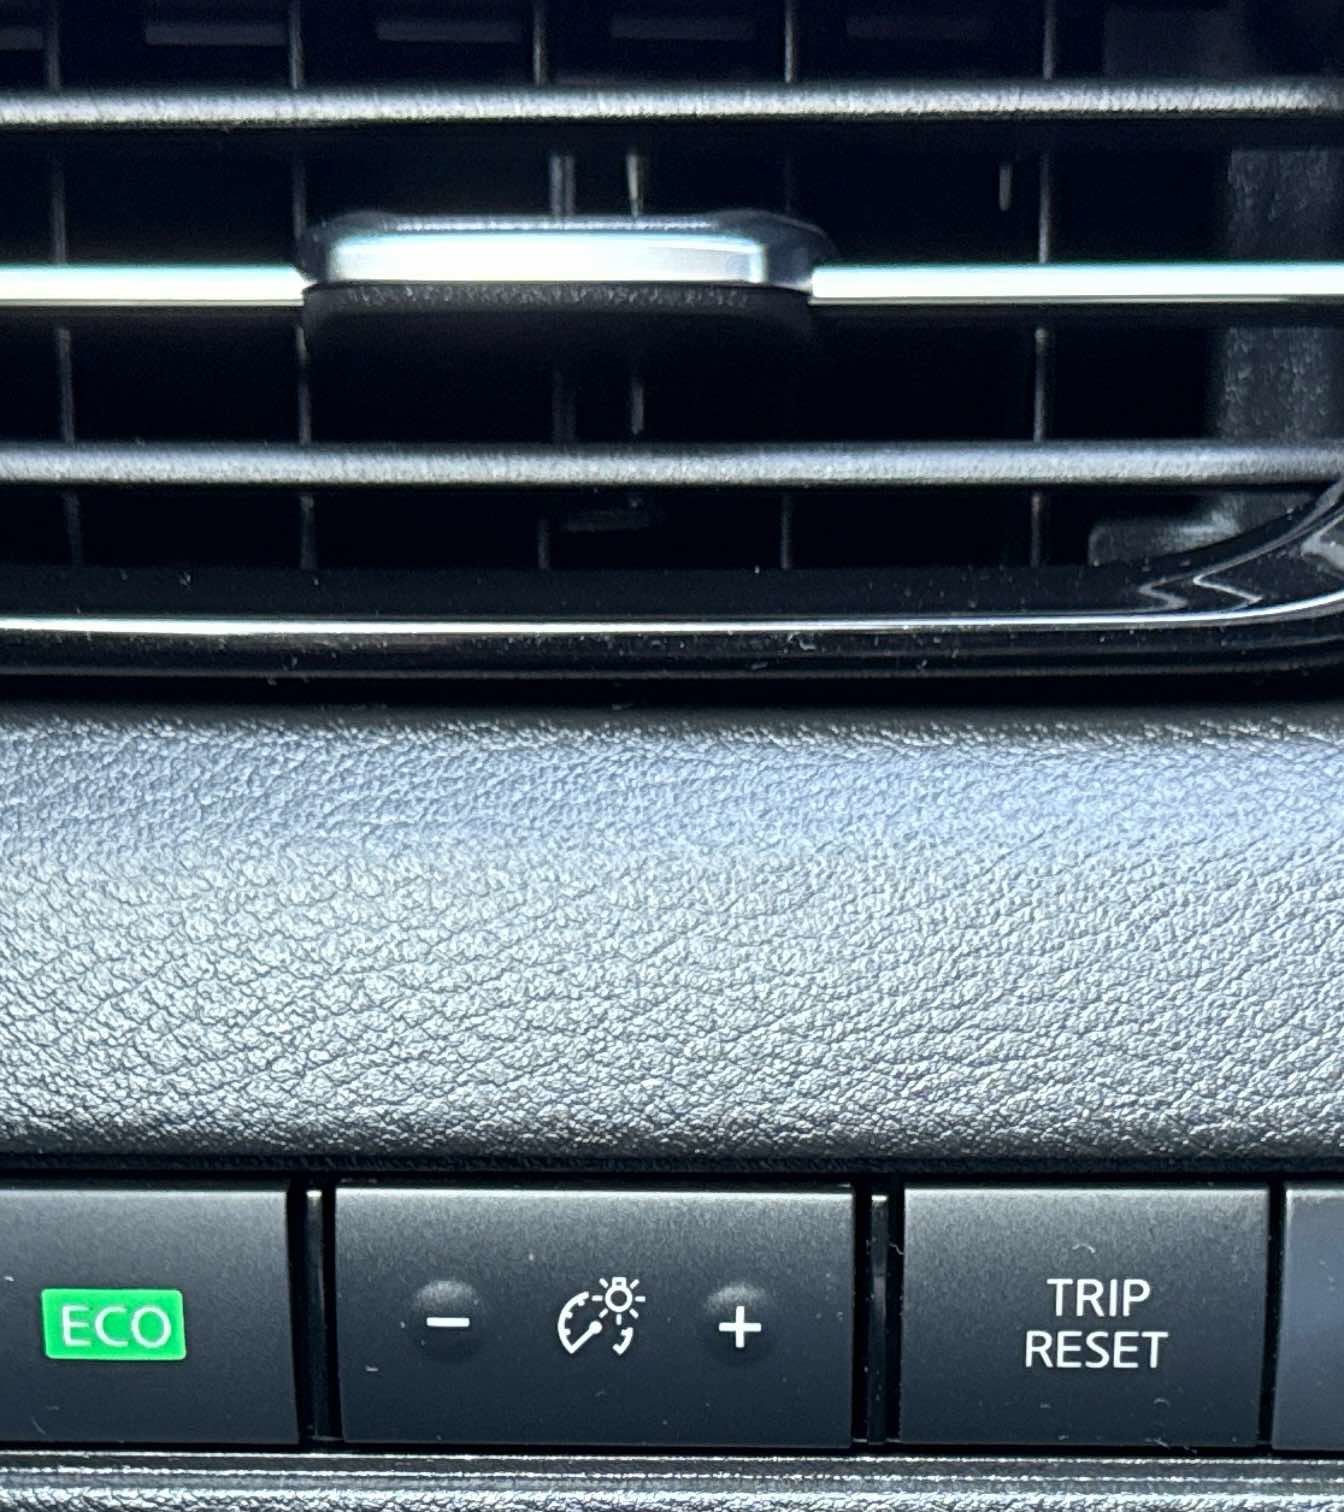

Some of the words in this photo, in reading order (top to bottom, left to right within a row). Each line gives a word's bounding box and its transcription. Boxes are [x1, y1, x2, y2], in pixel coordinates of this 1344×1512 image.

[1046, 1277, 1151, 1317] TRIP
[61, 1304, 172, 1349] ECO
[1024, 1329, 1169, 1369] RESET
